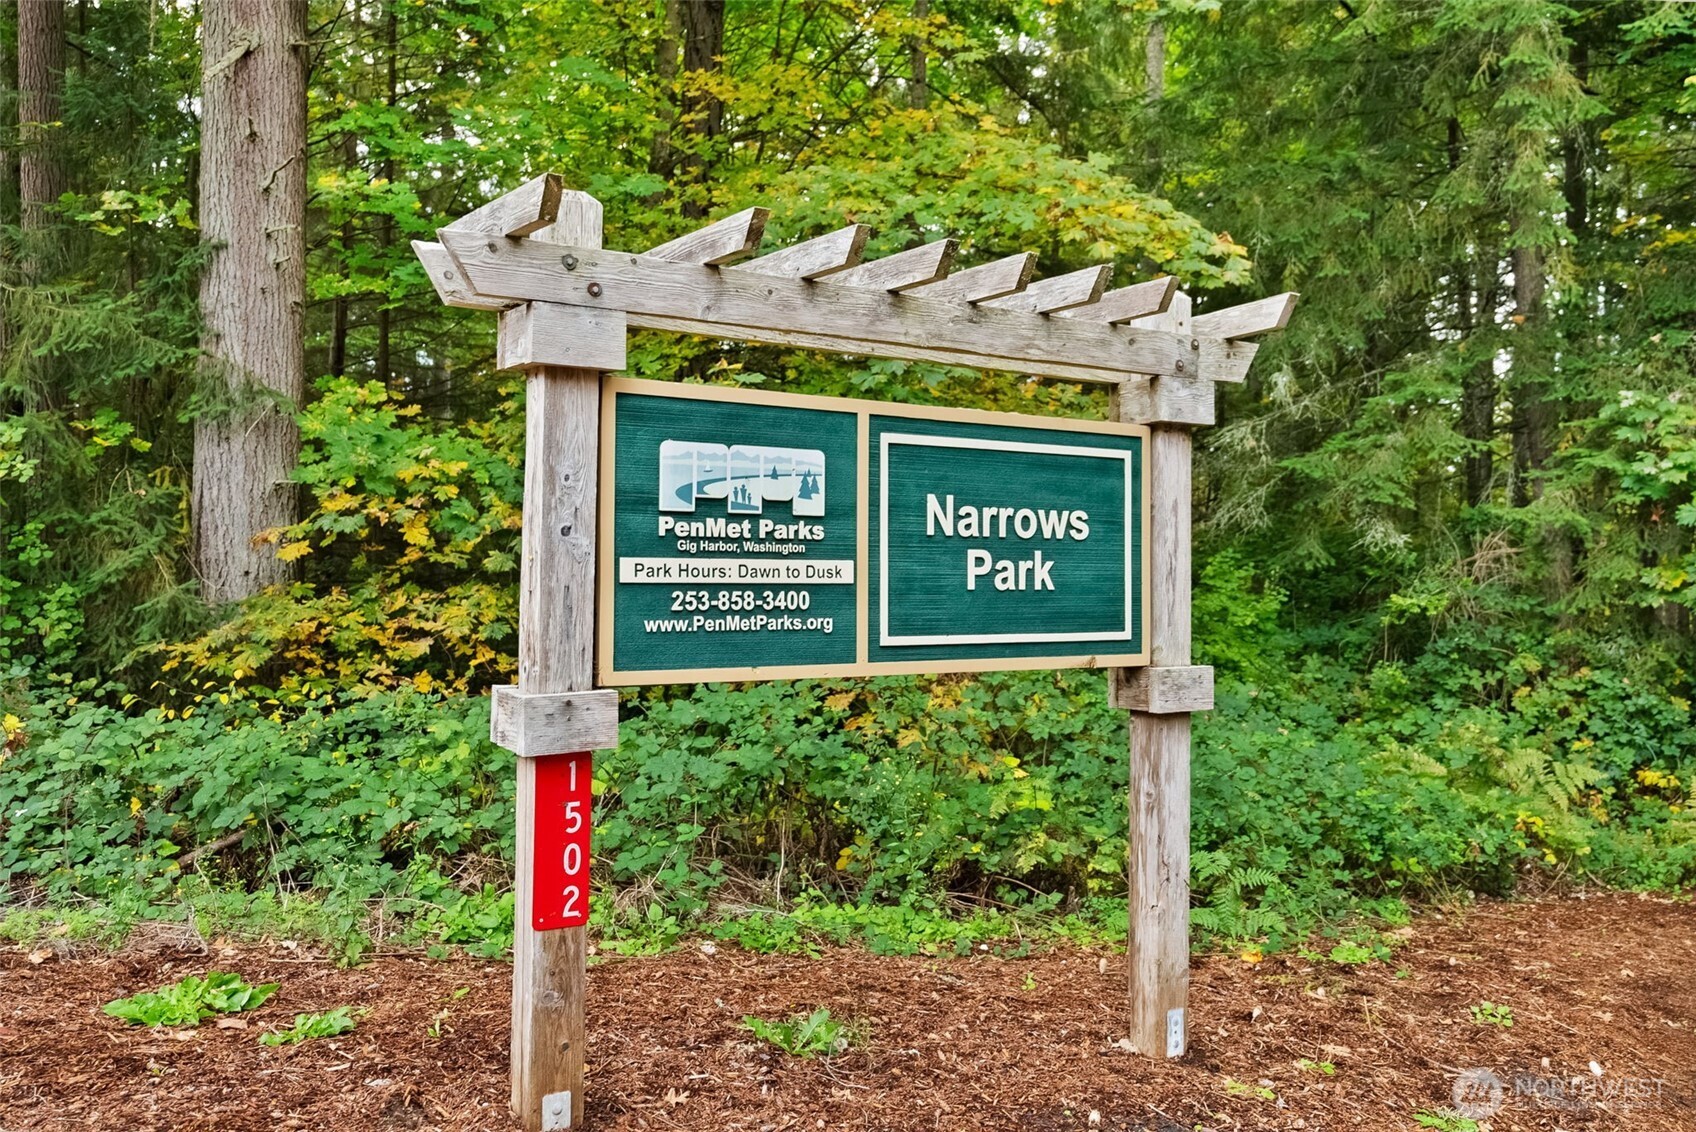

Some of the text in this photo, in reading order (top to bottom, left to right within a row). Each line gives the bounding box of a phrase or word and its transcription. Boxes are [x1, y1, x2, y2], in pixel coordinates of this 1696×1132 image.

[658, 516, 825, 540] PenMet Parks
[926, 493, 1090, 541] Narrows
[677, 540, 806, 555] Gig Harbor, Washington
[634, 562, 843, 579] Park Hours: Dawn to Dusk
[966, 548, 1055, 591] Park
[670, 590, 811, 611] 253-858-3400
[644, 615, 833, 634] www.PenMetParks.org
[562, 761, 582, 918] 1502
